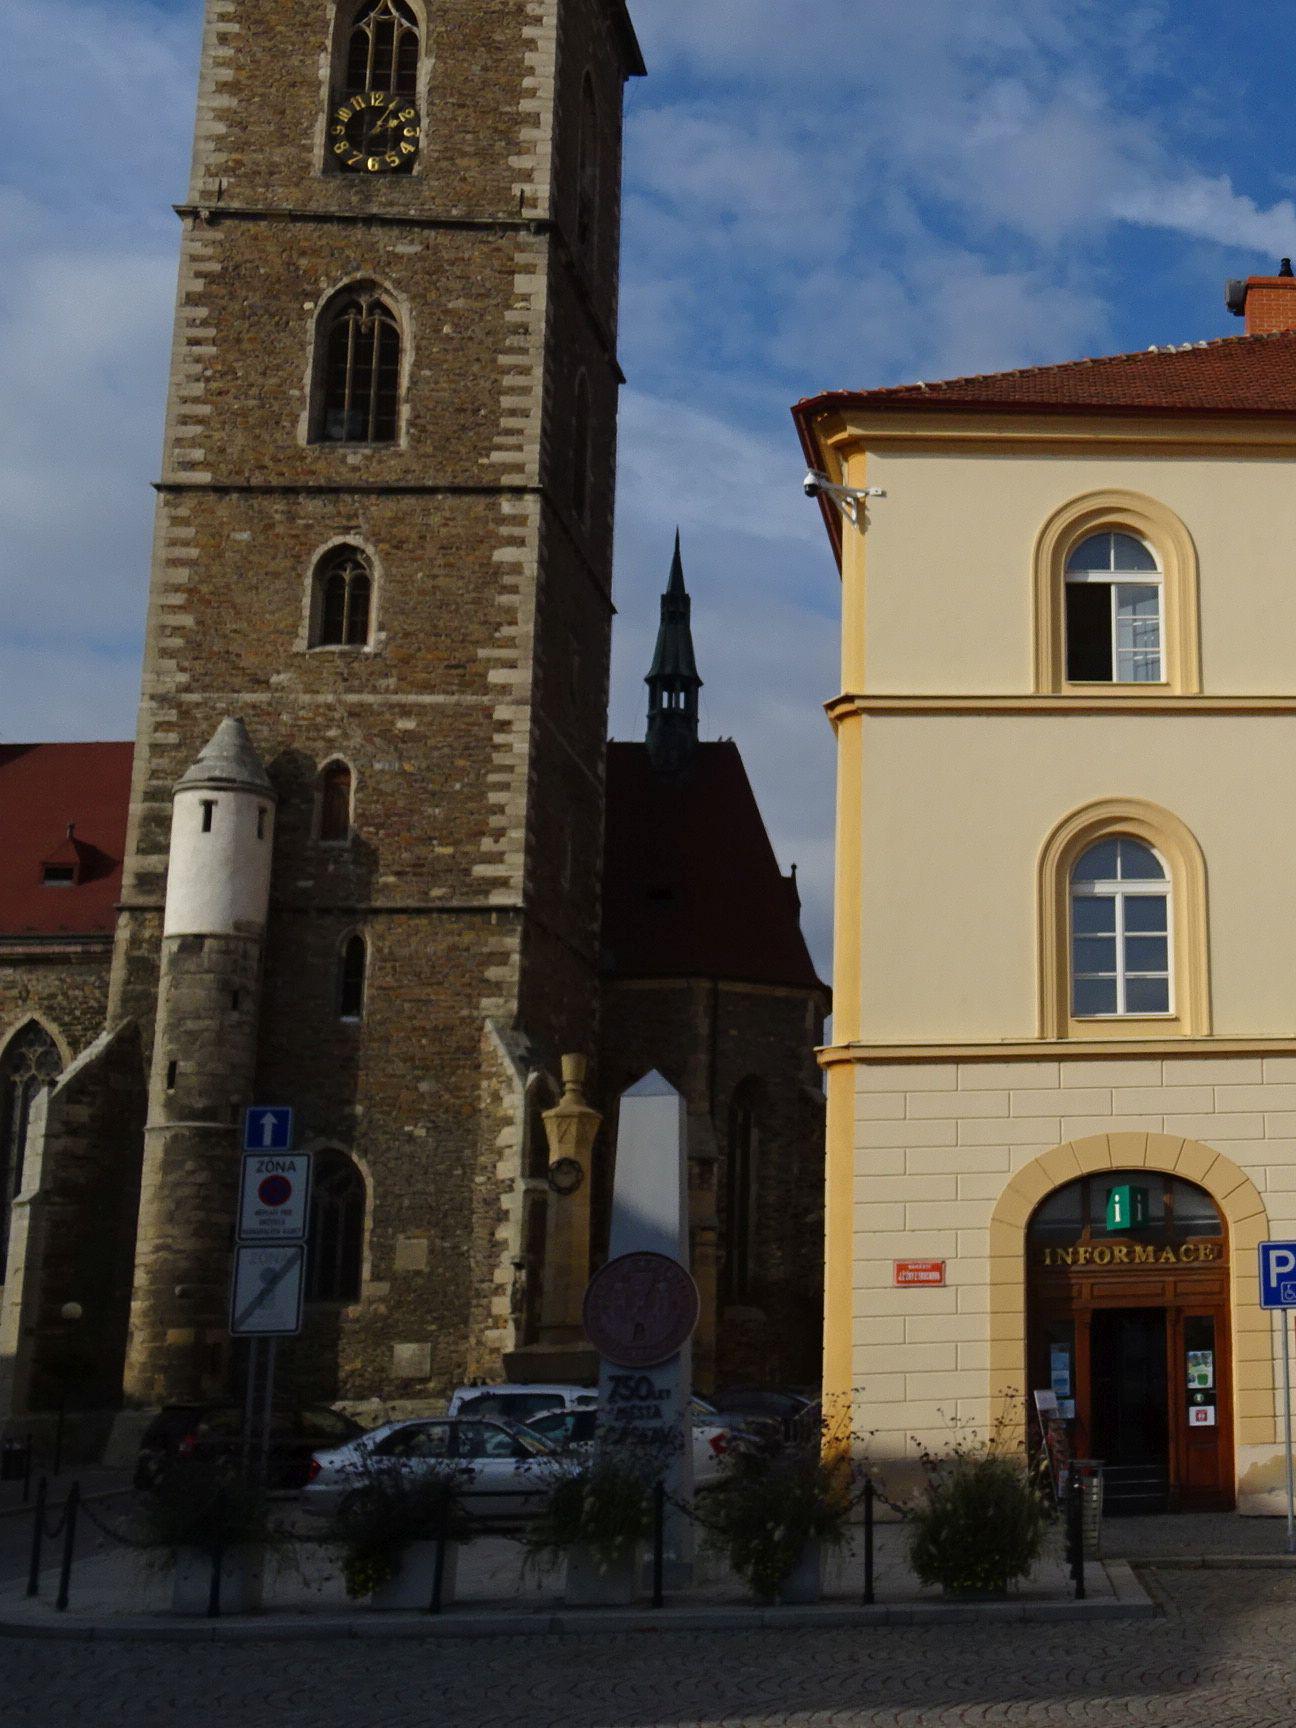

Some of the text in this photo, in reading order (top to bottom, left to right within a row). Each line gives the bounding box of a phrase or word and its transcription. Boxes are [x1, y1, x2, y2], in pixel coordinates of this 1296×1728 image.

[350, 95, 366, 111] 11
[369, 91, 384, 107] 12
[398, 108, 415, 122] 2
[331, 125, 346, 135] 9
[403, 126, 420, 138] 3
[333, 140, 349, 154] 8
[400, 141, 416, 154] 4
[346, 150, 364, 166] 7
[367, 156, 380, 172] 6
[385, 150, 400, 167] 5
[1043, 1243, 1215, 1266] INFORMACE
[1269, 1250, 1296, 1288] P
[608, 1375, 657, 1402] 750
